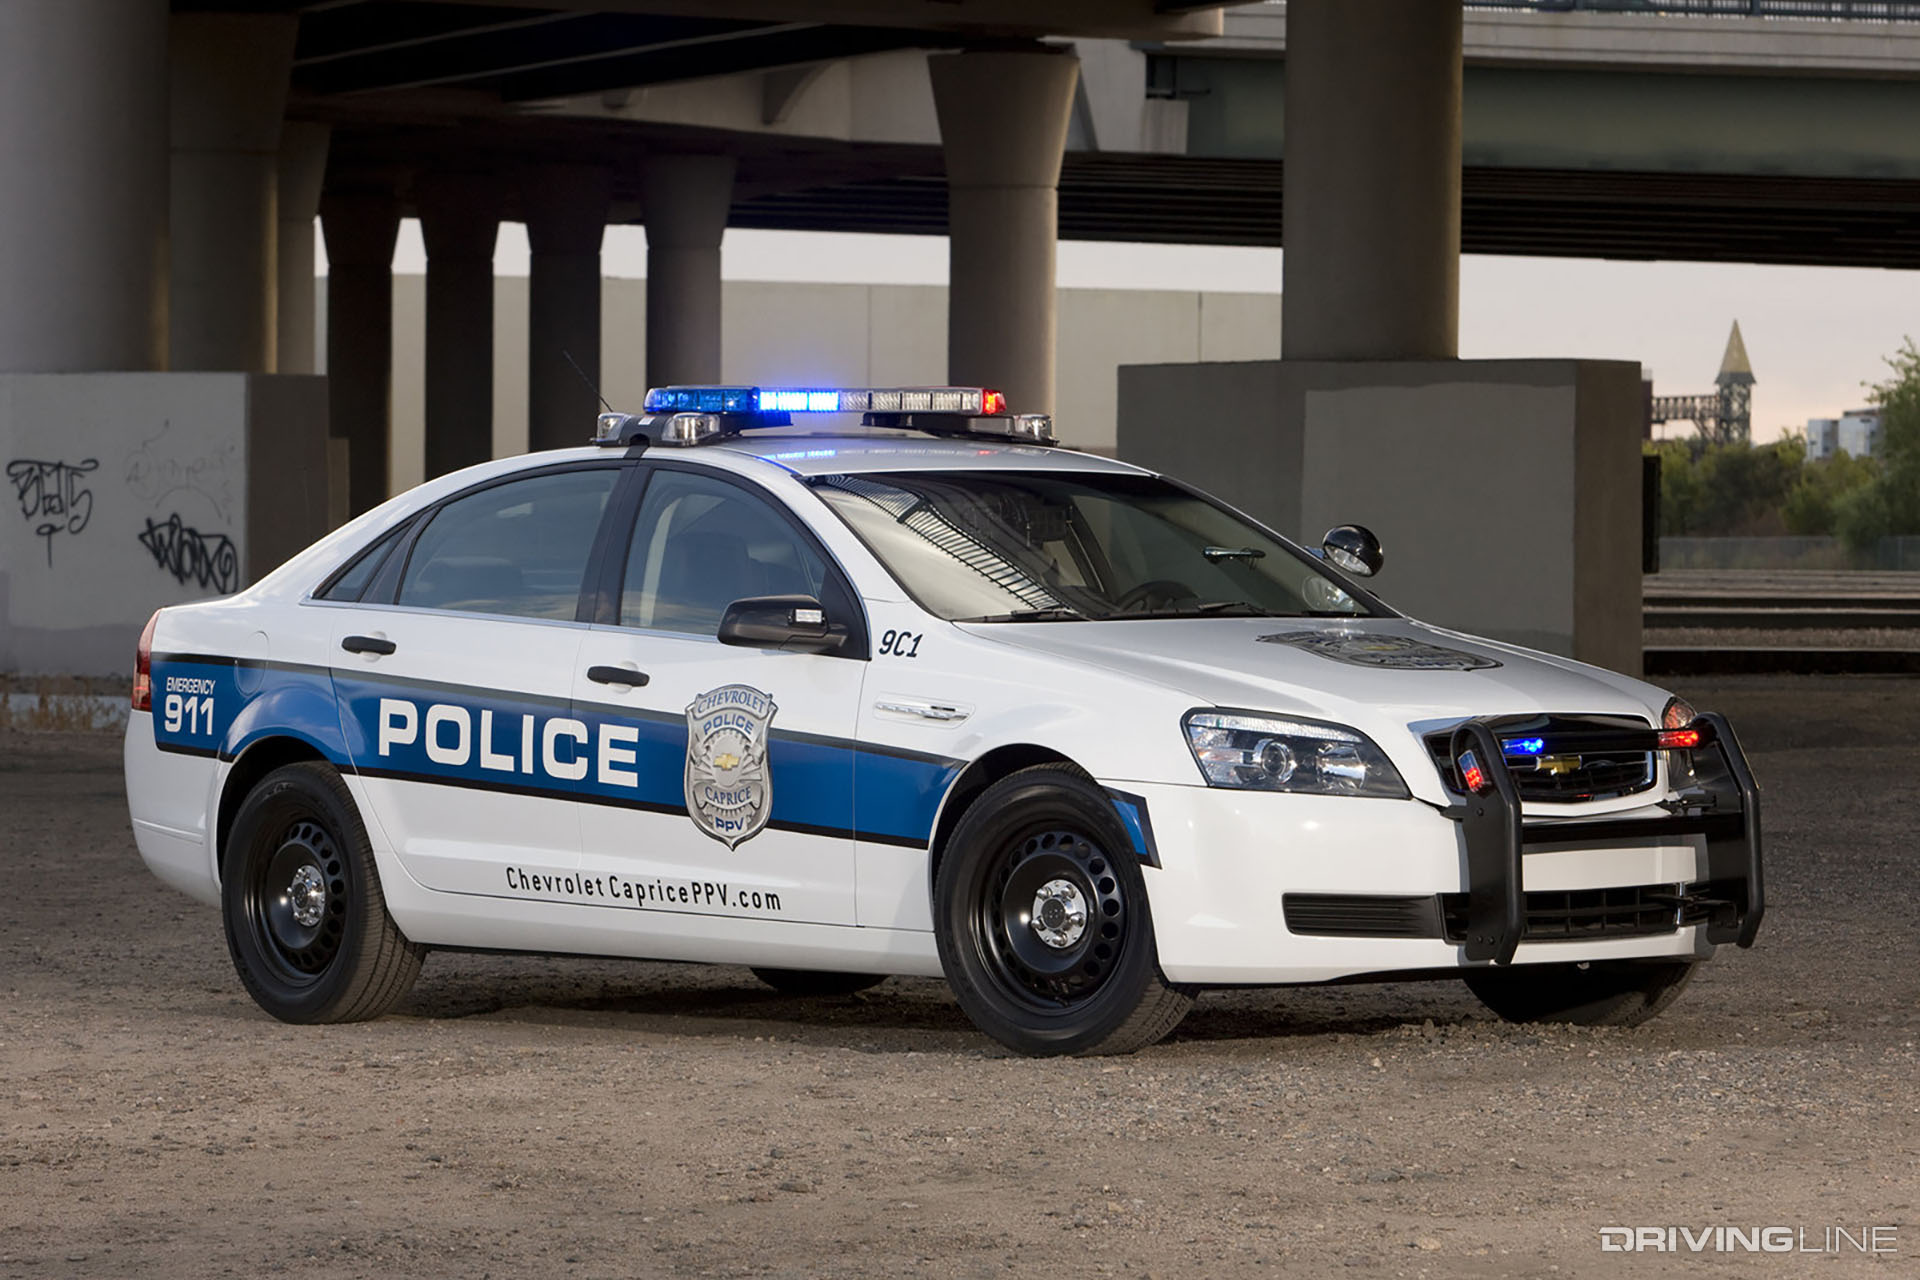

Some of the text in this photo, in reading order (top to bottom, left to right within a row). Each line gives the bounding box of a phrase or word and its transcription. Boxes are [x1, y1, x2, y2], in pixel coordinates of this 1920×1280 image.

[879, 629, 923, 658] 9C1
[166, 676, 216, 695] EMERGENCY
[697, 690, 765, 714] CHEVROLET
[165, 694, 214, 735] 911
[703, 713, 754, 736] POLICE
[378, 698, 639, 788] POLICE
[705, 785, 752, 806] CAPRICE
[715, 816, 744, 832] PPV
